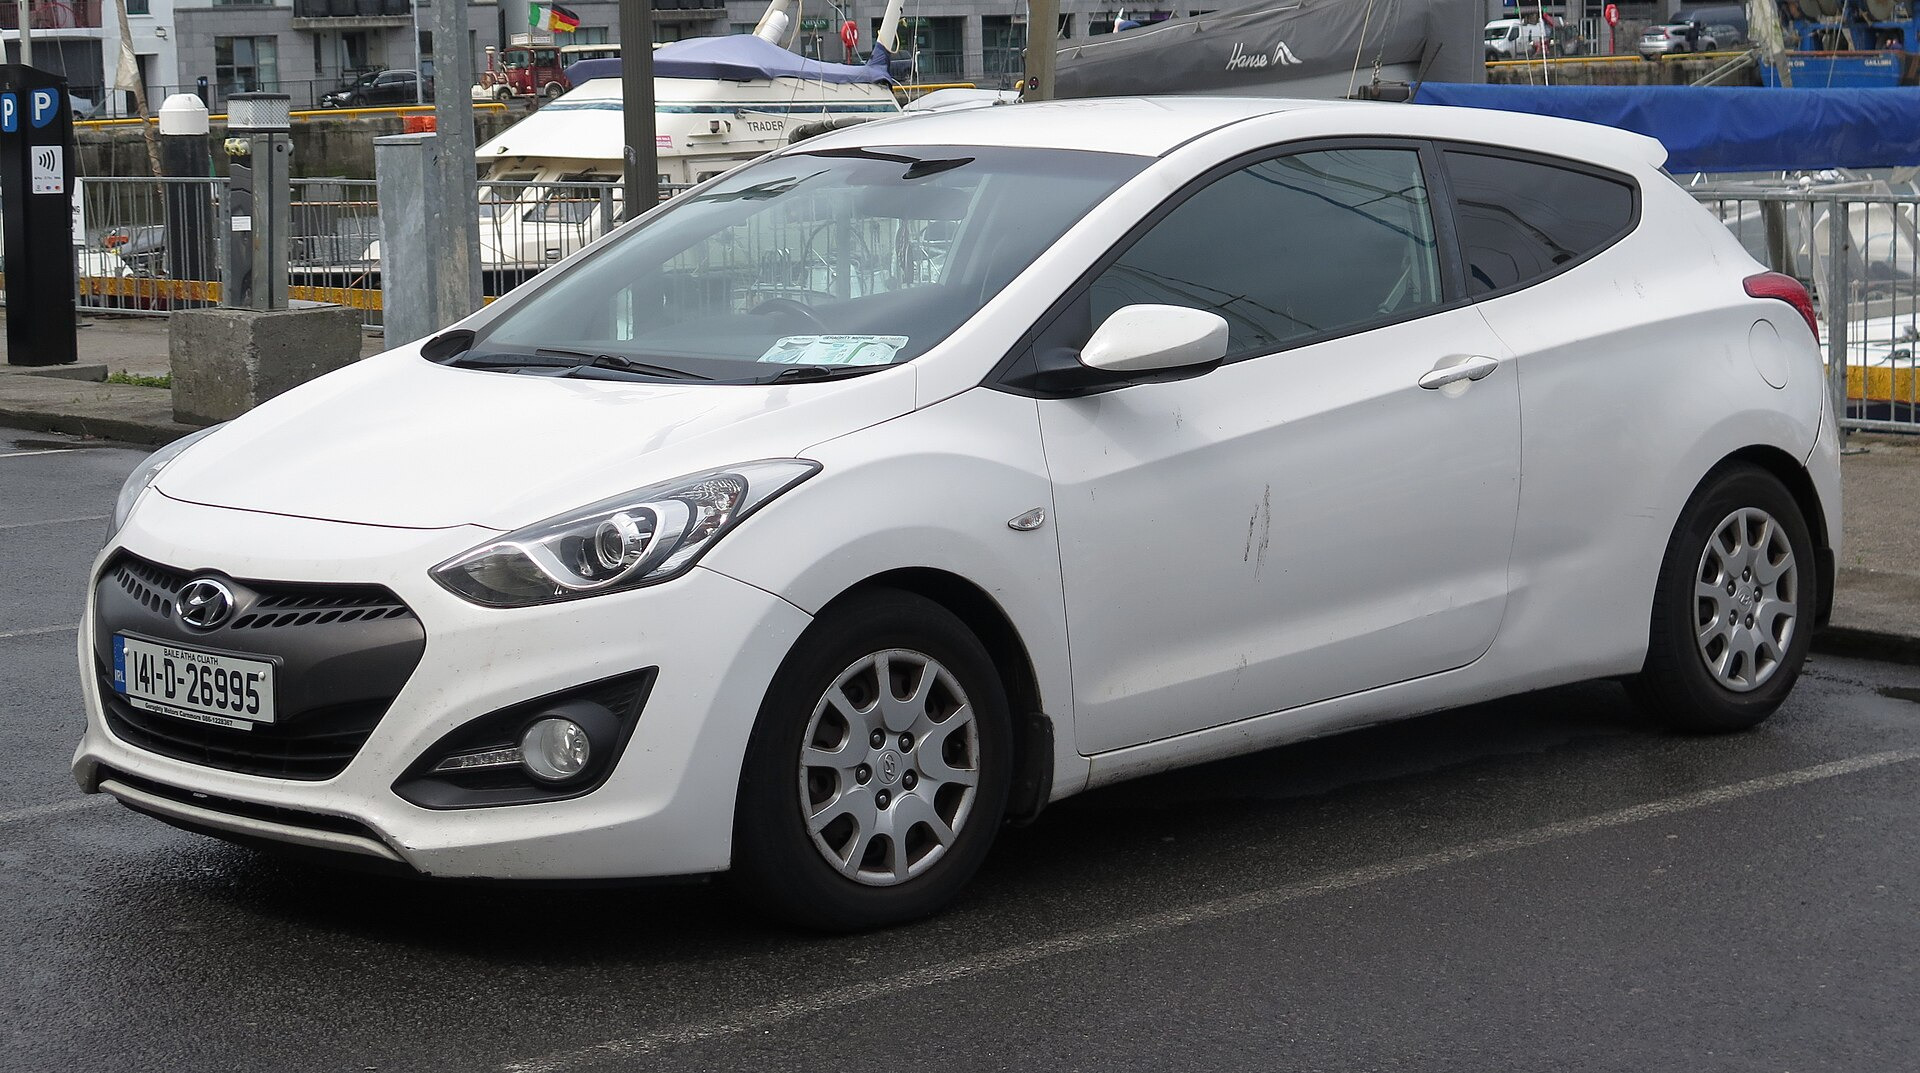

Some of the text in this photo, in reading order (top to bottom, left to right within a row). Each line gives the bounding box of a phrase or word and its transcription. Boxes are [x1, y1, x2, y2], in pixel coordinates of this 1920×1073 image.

[1225, 42, 1268, 71] Hanse
[3, 98, 14, 127] P
[34, 92, 51, 121] P
[747, 120, 784, 132] TRADER
[163, 648, 180, 659] BAILE
[196, 654, 219, 666] CLIATH
[114, 669, 125, 683] IRL
[133, 650, 260, 716] 141-D-26995
